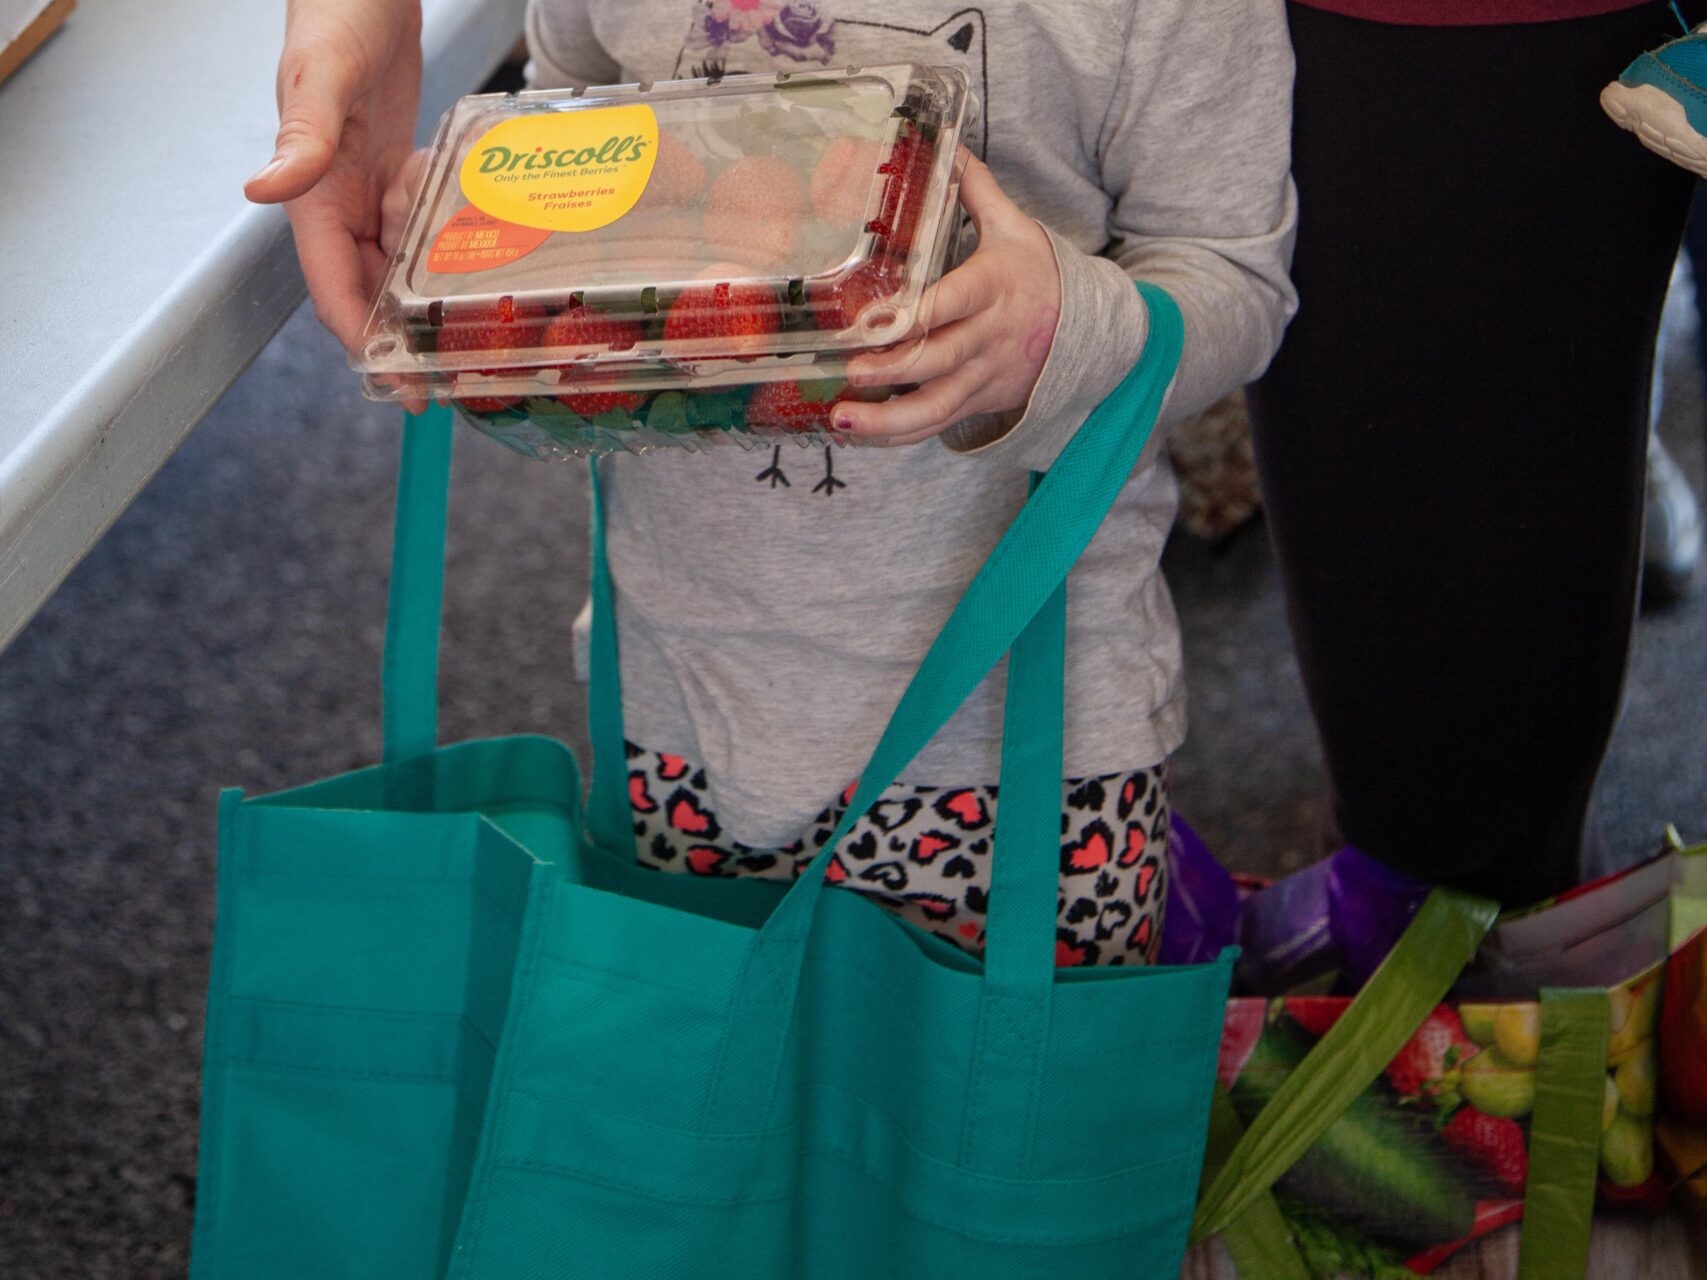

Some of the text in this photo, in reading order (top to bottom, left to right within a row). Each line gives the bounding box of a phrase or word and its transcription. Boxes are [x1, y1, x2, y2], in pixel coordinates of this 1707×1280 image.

[479, 134, 648, 174] Driscoll's
[494, 166, 619, 183] Only the Finest Berries
[528, 186, 616, 202] Strawberries
[543, 200, 593, 211] Fraises
